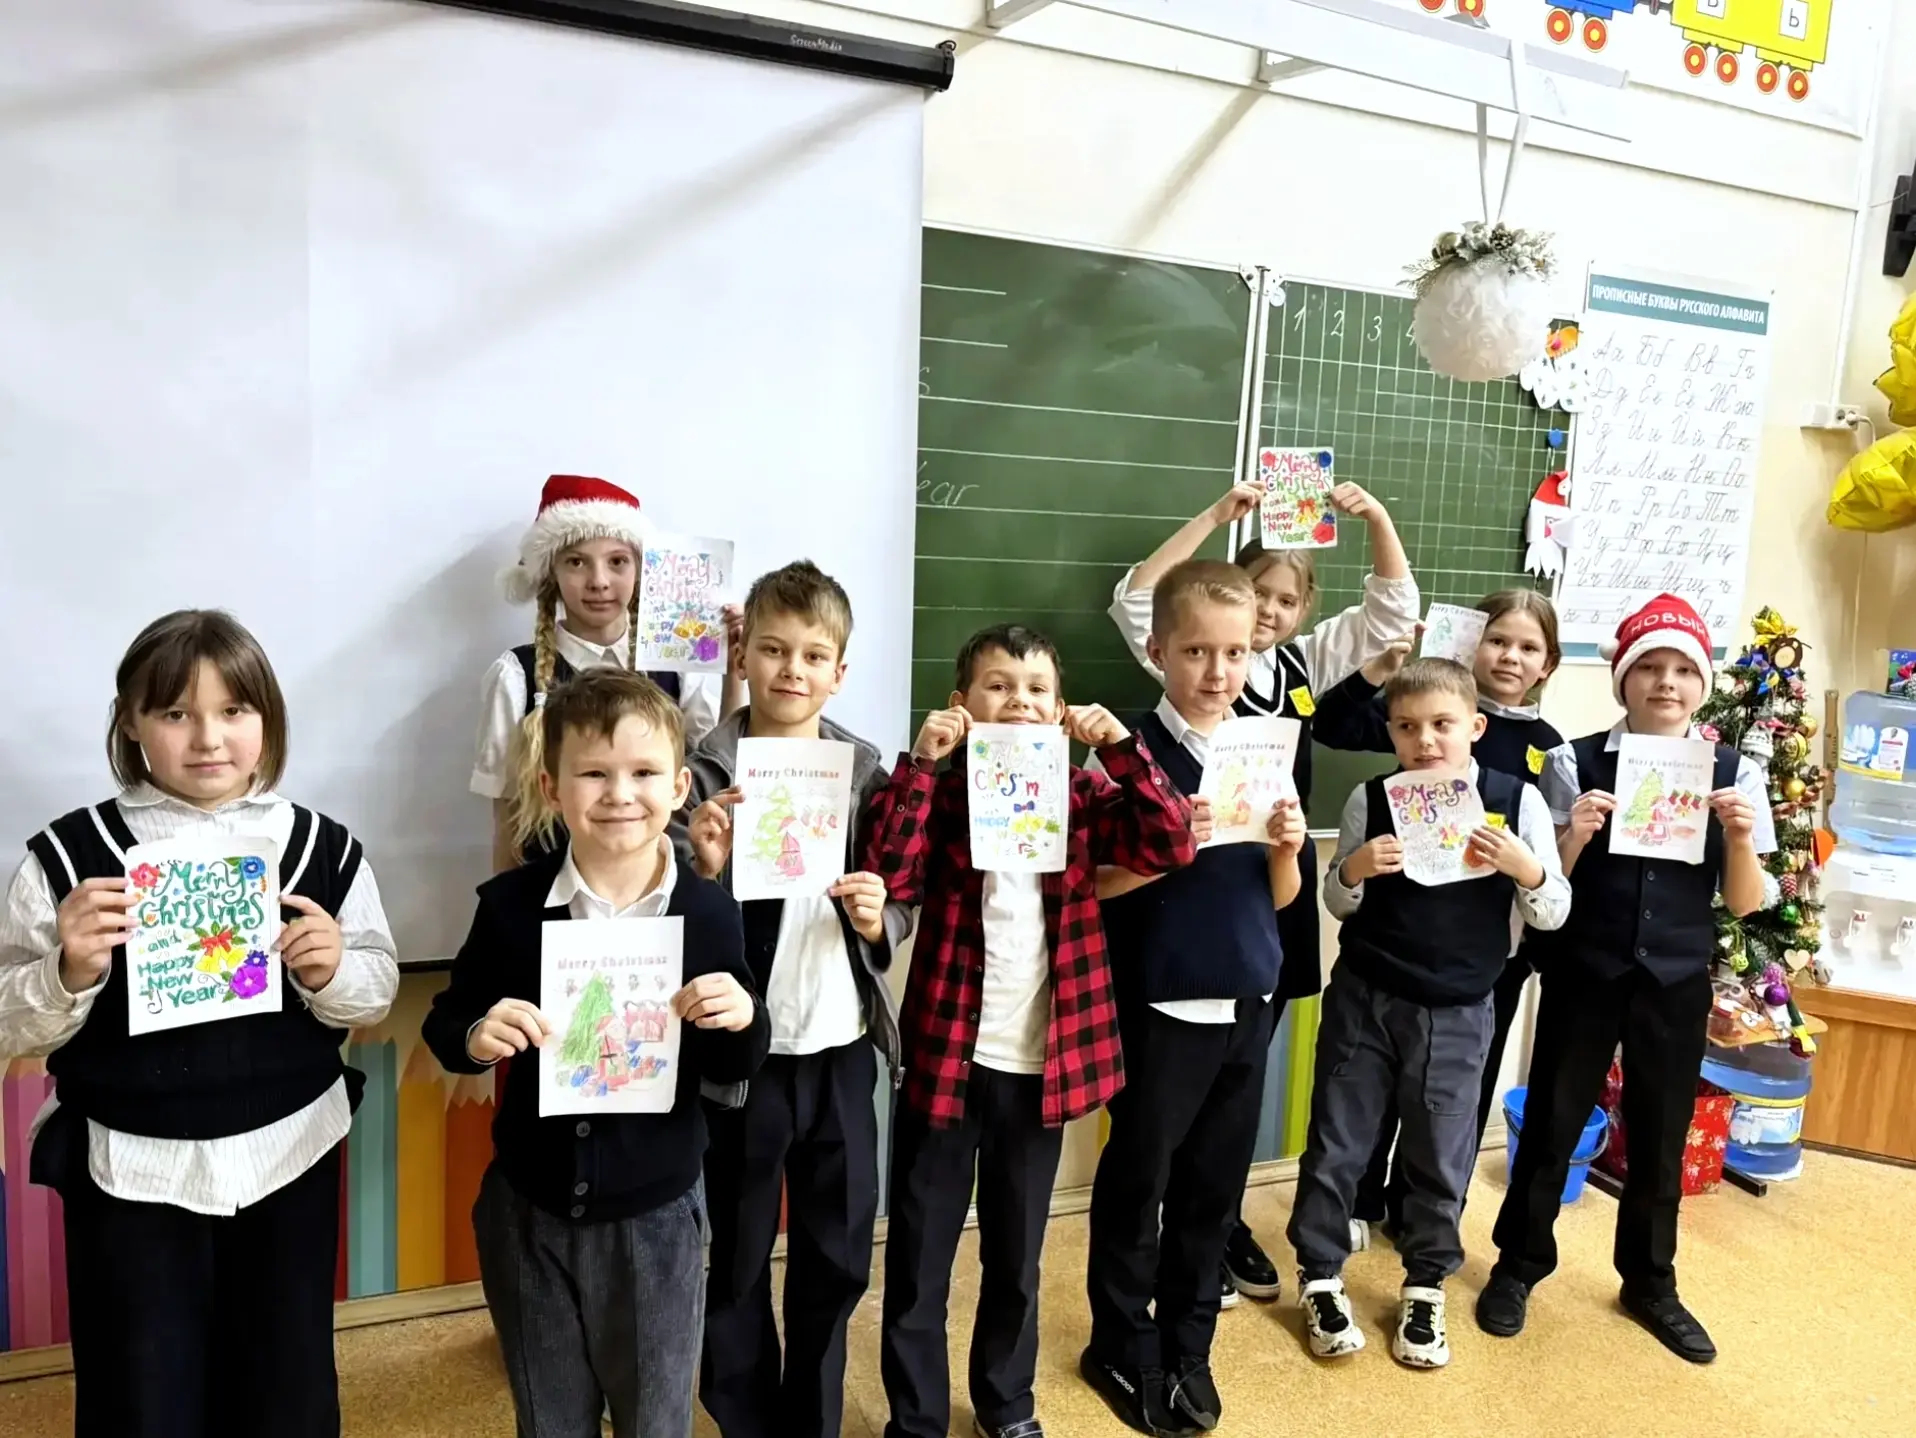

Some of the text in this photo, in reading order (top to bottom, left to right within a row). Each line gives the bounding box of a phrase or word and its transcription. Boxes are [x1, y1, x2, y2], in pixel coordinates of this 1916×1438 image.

[1592, 284, 1765, 324] ПРОПИСНЫЕ БУКВЫ РУССКОГО АЛФАВИТА
[1294, 304, 1306, 332] 1
[1330, 310, 1344, 336] 2
[1367, 315, 1382, 342] 3
[917, 461, 980, 508] ear
[1269, 495, 1287, 506] and
[1268, 522, 1292, 531] New
[1278, 531, 1307, 543] Year
[748, 766, 840, 780] Merry Christmas
[151, 860, 246, 905] Merry
[138, 892, 265, 930] Christmas
[148, 929, 181, 952] and
[137, 954, 196, 977] Happy
[148, 972, 193, 990] New
[167, 984, 217, 1008] Year
